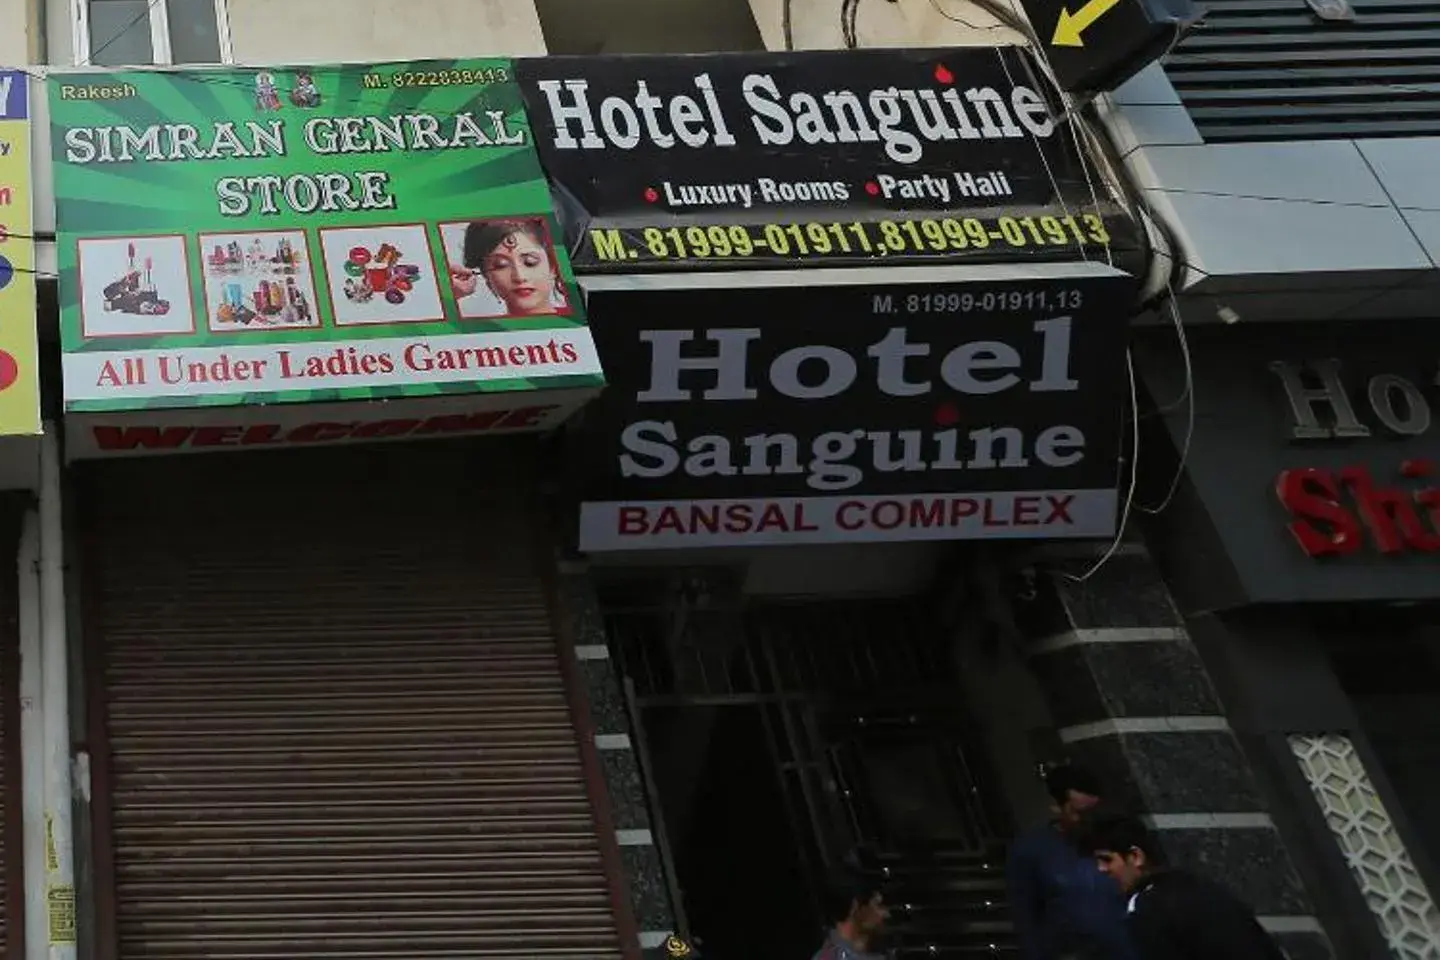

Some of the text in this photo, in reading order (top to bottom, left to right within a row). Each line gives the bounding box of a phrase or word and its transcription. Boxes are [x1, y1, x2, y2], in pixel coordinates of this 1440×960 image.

[62, 82, 136, 100] Rakesh
[363, 73, 389, 89] M.
[65, 110, 527, 164] SIMRAN GENRAL
[539, 65, 1059, 163] Hotel Sanguine
[216, 172, 397, 217] STORE
[664, 180, 755, 208] Luxury
[761, 178, 849, 202] Rooms
[879, 176, 949, 204] Party
[592, 228, 637, 261] M.
[873, 290, 1082, 313] M. 81999-01911,13
[96, 336, 578, 388] All Under Ladies Garments
[636, 317, 1079, 402] Hotel
[1268, 357, 1440, 437] Ho
[92, 403, 564, 450] WELCOME
[619, 401, 1085, 490] Sanguine
[618, 495, 1074, 535] BANSAL COMPLEX
